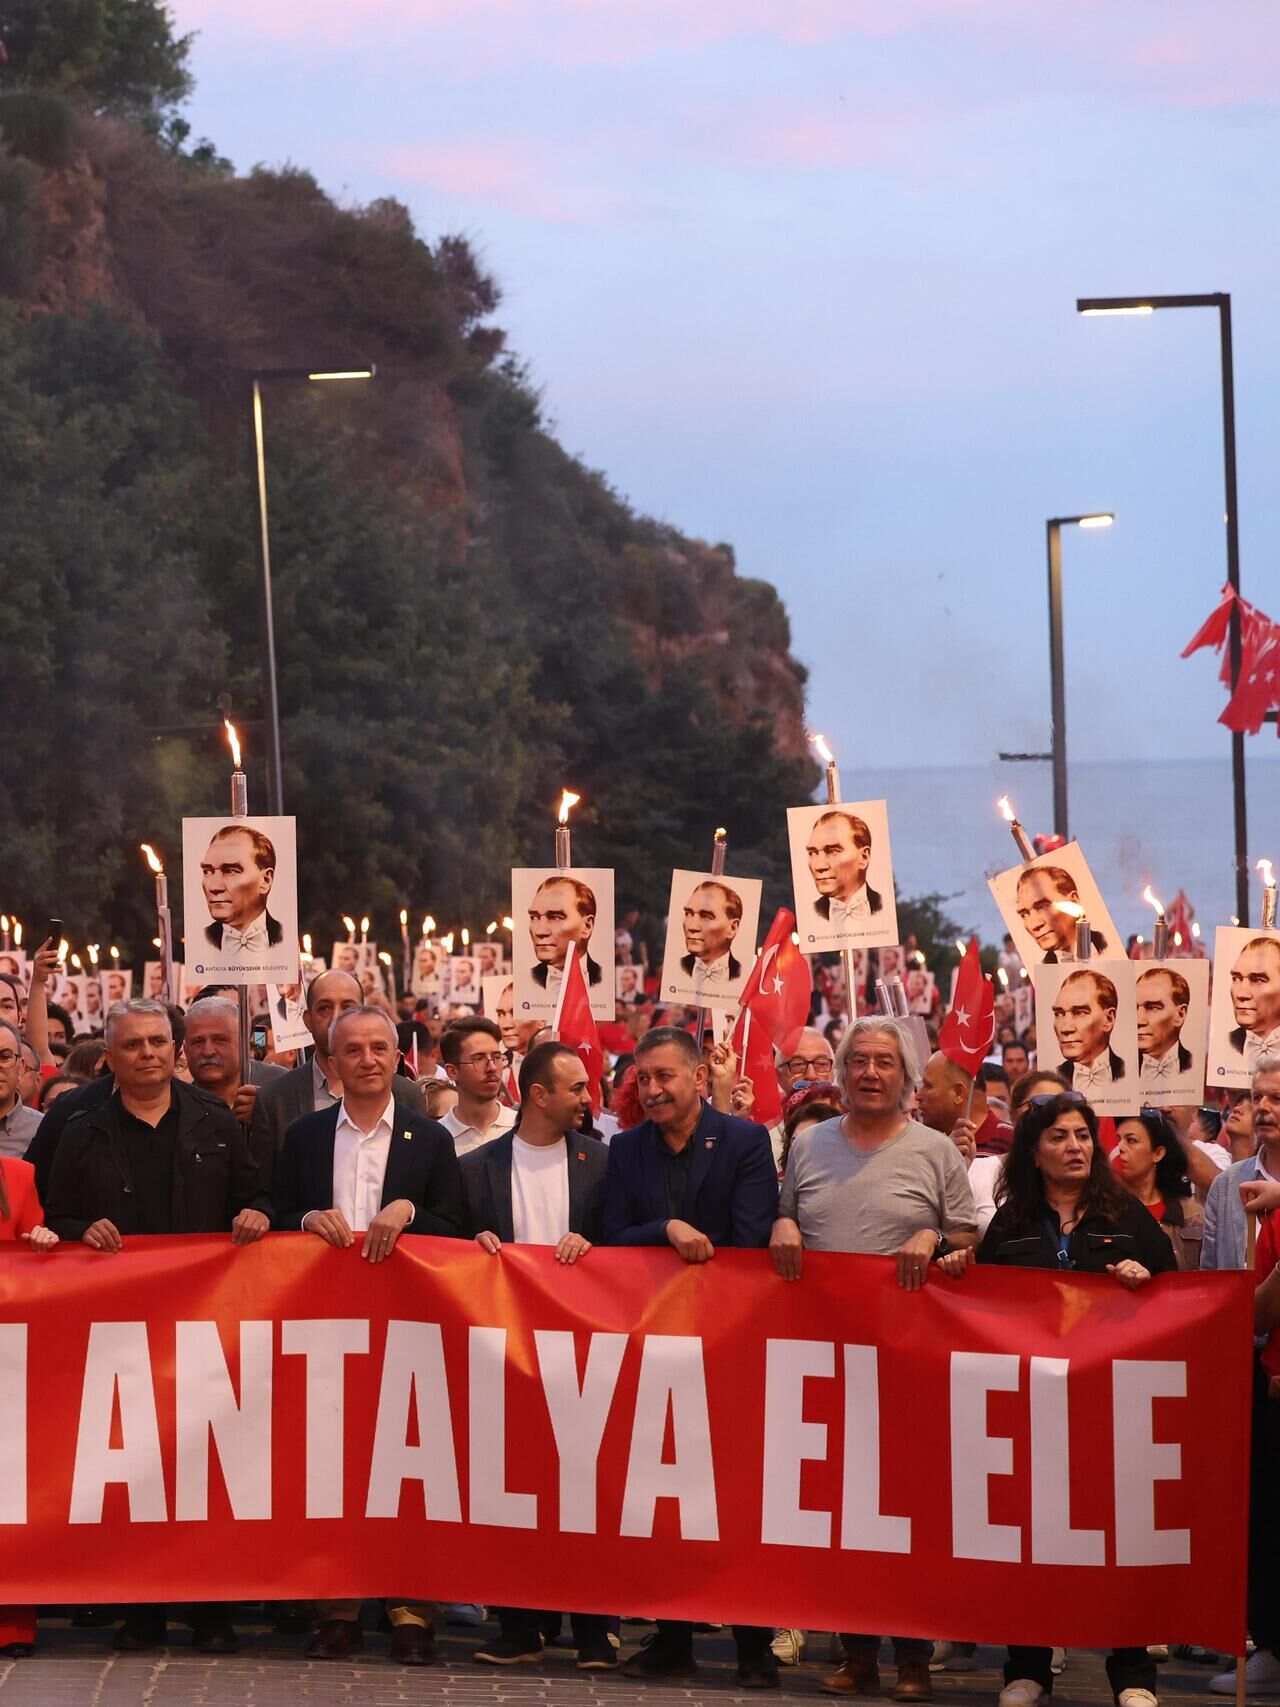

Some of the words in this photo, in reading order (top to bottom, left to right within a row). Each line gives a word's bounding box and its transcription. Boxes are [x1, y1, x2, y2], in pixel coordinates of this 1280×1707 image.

[68, 1318, 720, 1541] ANTALYA
[761, 1338, 912, 1554] EL
[950, 1351, 1191, 1567] ELE
